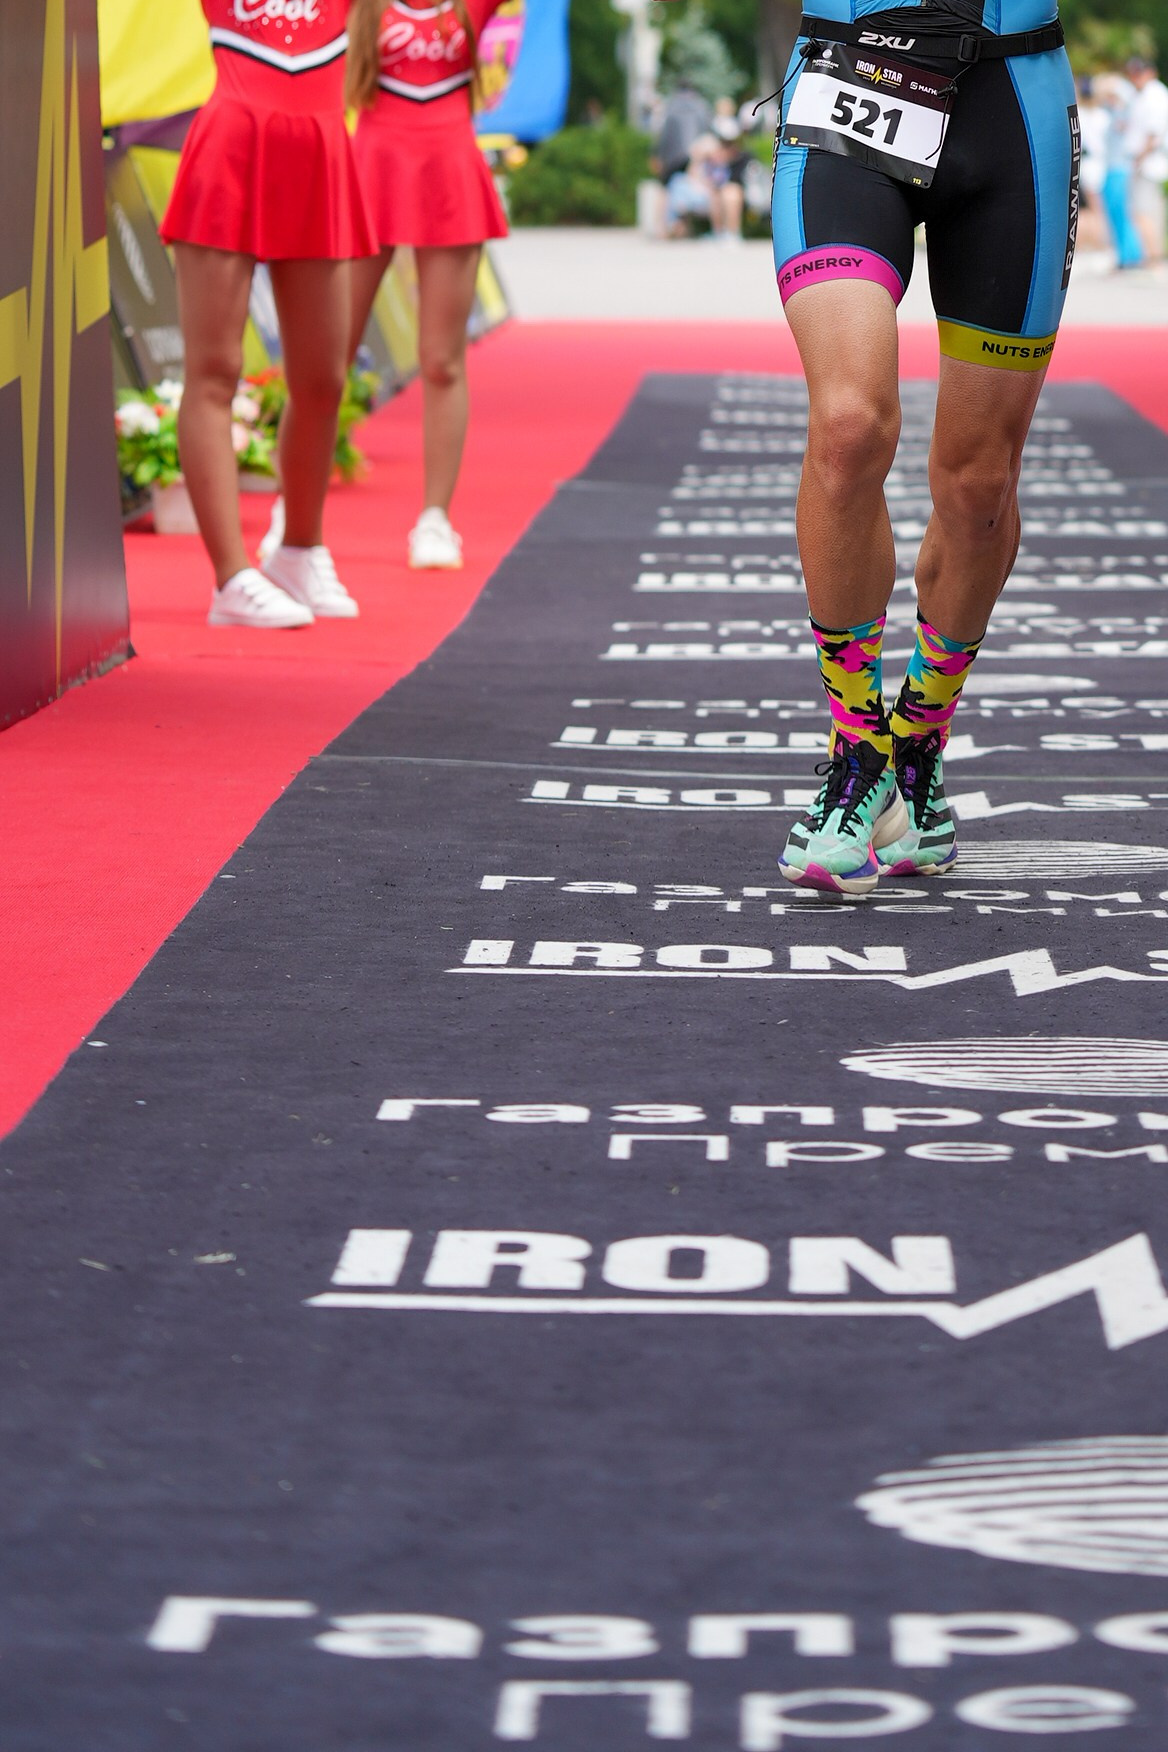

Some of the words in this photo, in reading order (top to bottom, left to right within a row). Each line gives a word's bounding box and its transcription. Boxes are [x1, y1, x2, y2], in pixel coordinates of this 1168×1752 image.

[857, 30, 916, 51] 2XU
[855, 59, 876, 75] IRON
[882, 68, 903, 85] STAR
[918, 85, 938, 96] МАГН
[829, 90, 904, 146] 521
[793, 256, 864, 278] ENERGY
[982, 340, 1031, 359] NUTS
[462, 939, 908, 971] IRON
[331, 1227, 956, 1295] IRON
